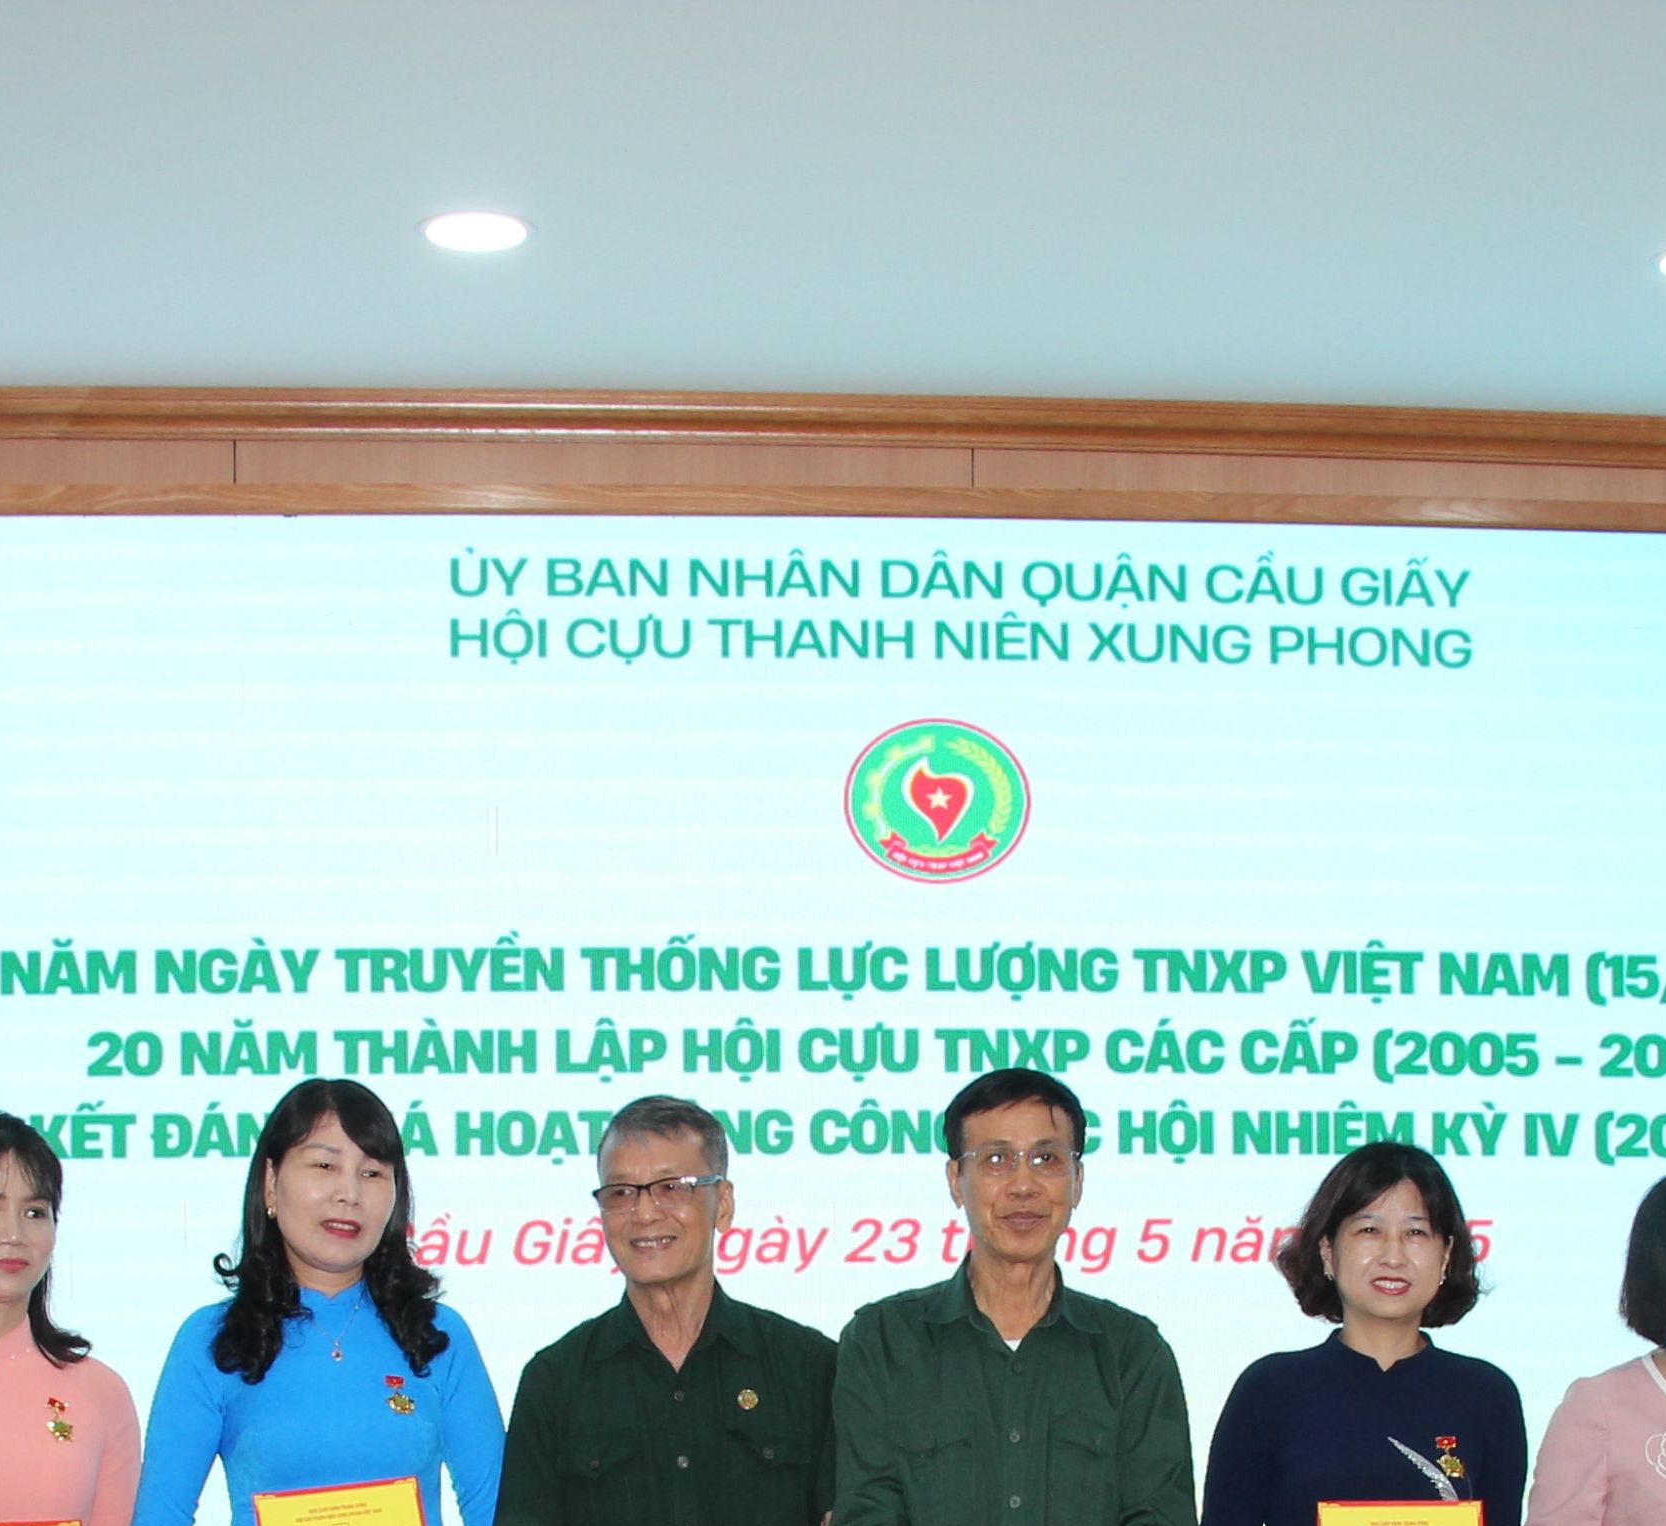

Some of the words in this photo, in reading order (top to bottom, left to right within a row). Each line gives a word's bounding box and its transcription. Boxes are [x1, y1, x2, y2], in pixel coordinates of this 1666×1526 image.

[450, 546, 528, 598] ỦY
[546, 557, 669, 598] BAN
[688, 547, 861, 598] NHÂN
[880, 548, 1004, 600] DÂN
[1021, 551, 1188, 609] QUẬN
[1204, 550, 1325, 606] CẦU
[1340, 556, 1471, 609] GIẤY
[449, 607, 548, 665] HỘI
[565, 613, 692, 665] CỰU
[707, 618, 915, 660] THANH
[934, 610, 1070, 662] NIÊN
[1088, 621, 1252, 665] XUNG
[1269, 624, 1474, 670] PHONG
[0, 938, 137, 996] NĂM
[154, 937, 321, 994] NGÀY
[334, 930, 565, 992] TRUYỀN
[580, 933, 782, 992] THỐNG
[797, 941, 909, 1000] LỰC
[925, 941, 1120, 1001] LƯỢNG
[1133, 949, 1288, 993] TNXP
[1301, 940, 1424, 1003] VIỆT
[1439, 950, 1571, 998] NAM
[86, 1030, 164, 1078] 20
[180, 1018, 320, 1075] NĂM
[334, 1018, 538, 1075] THÀNH
[555, 1017, 668, 1083] LẬP
[682, 1017, 782, 1083] HỘI
[797, 1022, 920, 1083] CỰU
[934, 1028, 1091, 1073] TNXP
[1105, 1017, 1226, 1075] CÁC
[1240, 1016, 1359, 1076] CẤP
[1372, 1027, 1541, 1085] (2005
[150, 1101, 273, 1159] ĐÁN
[809, 1098, 949, 1156] CÔN
[1117, 1098, 1215, 1165] HỘI
[1432, 1101, 1508, 1157] KỲ
[1524, 1112, 1581, 1158] IV
[406, 1213, 493, 1266] ầu
[717, 1215, 829, 1274] gày
[845, 1218, 922, 1264] 23
[1137, 1218, 1171, 1264] 5
